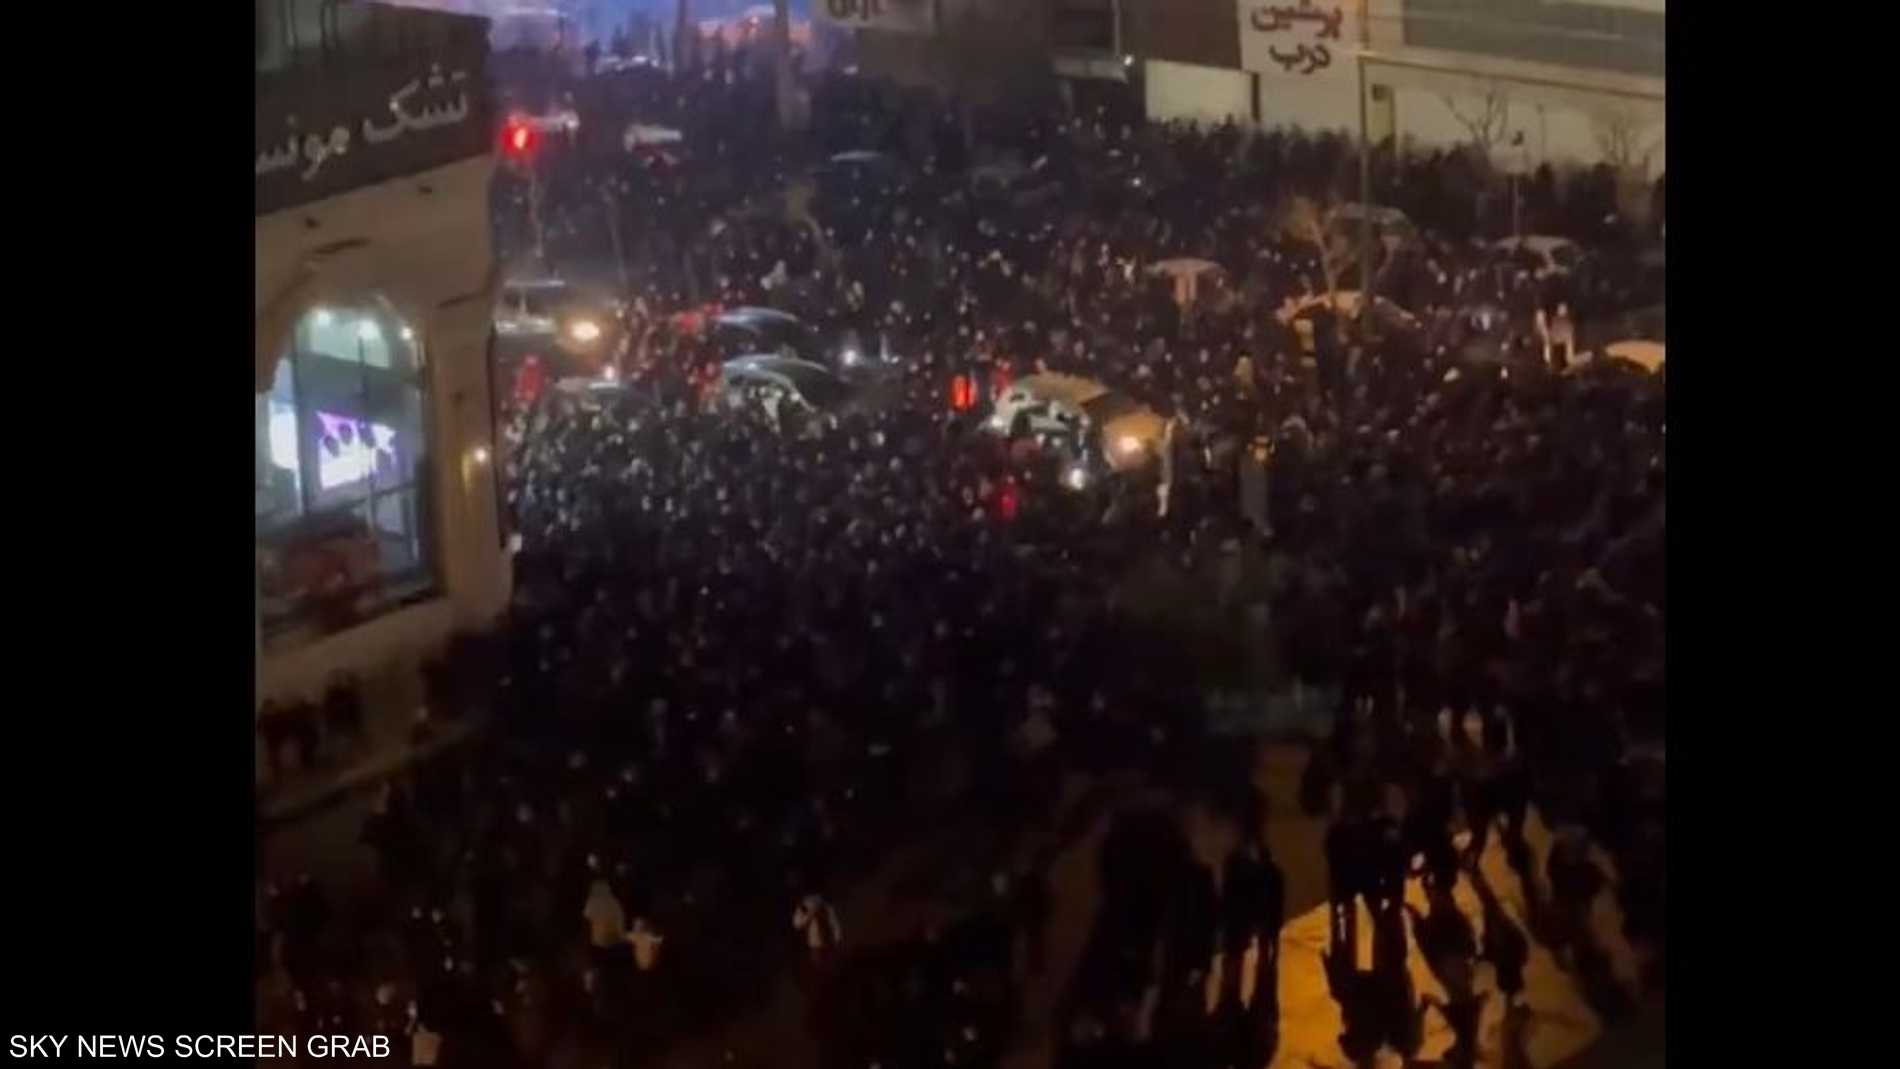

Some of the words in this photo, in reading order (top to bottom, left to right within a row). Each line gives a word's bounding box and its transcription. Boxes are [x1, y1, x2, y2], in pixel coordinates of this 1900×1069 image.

[1251, 0, 1342, 41] پرشین
[1268, 44, 1331, 74] درب
[362, 62, 468, 143] تشک
